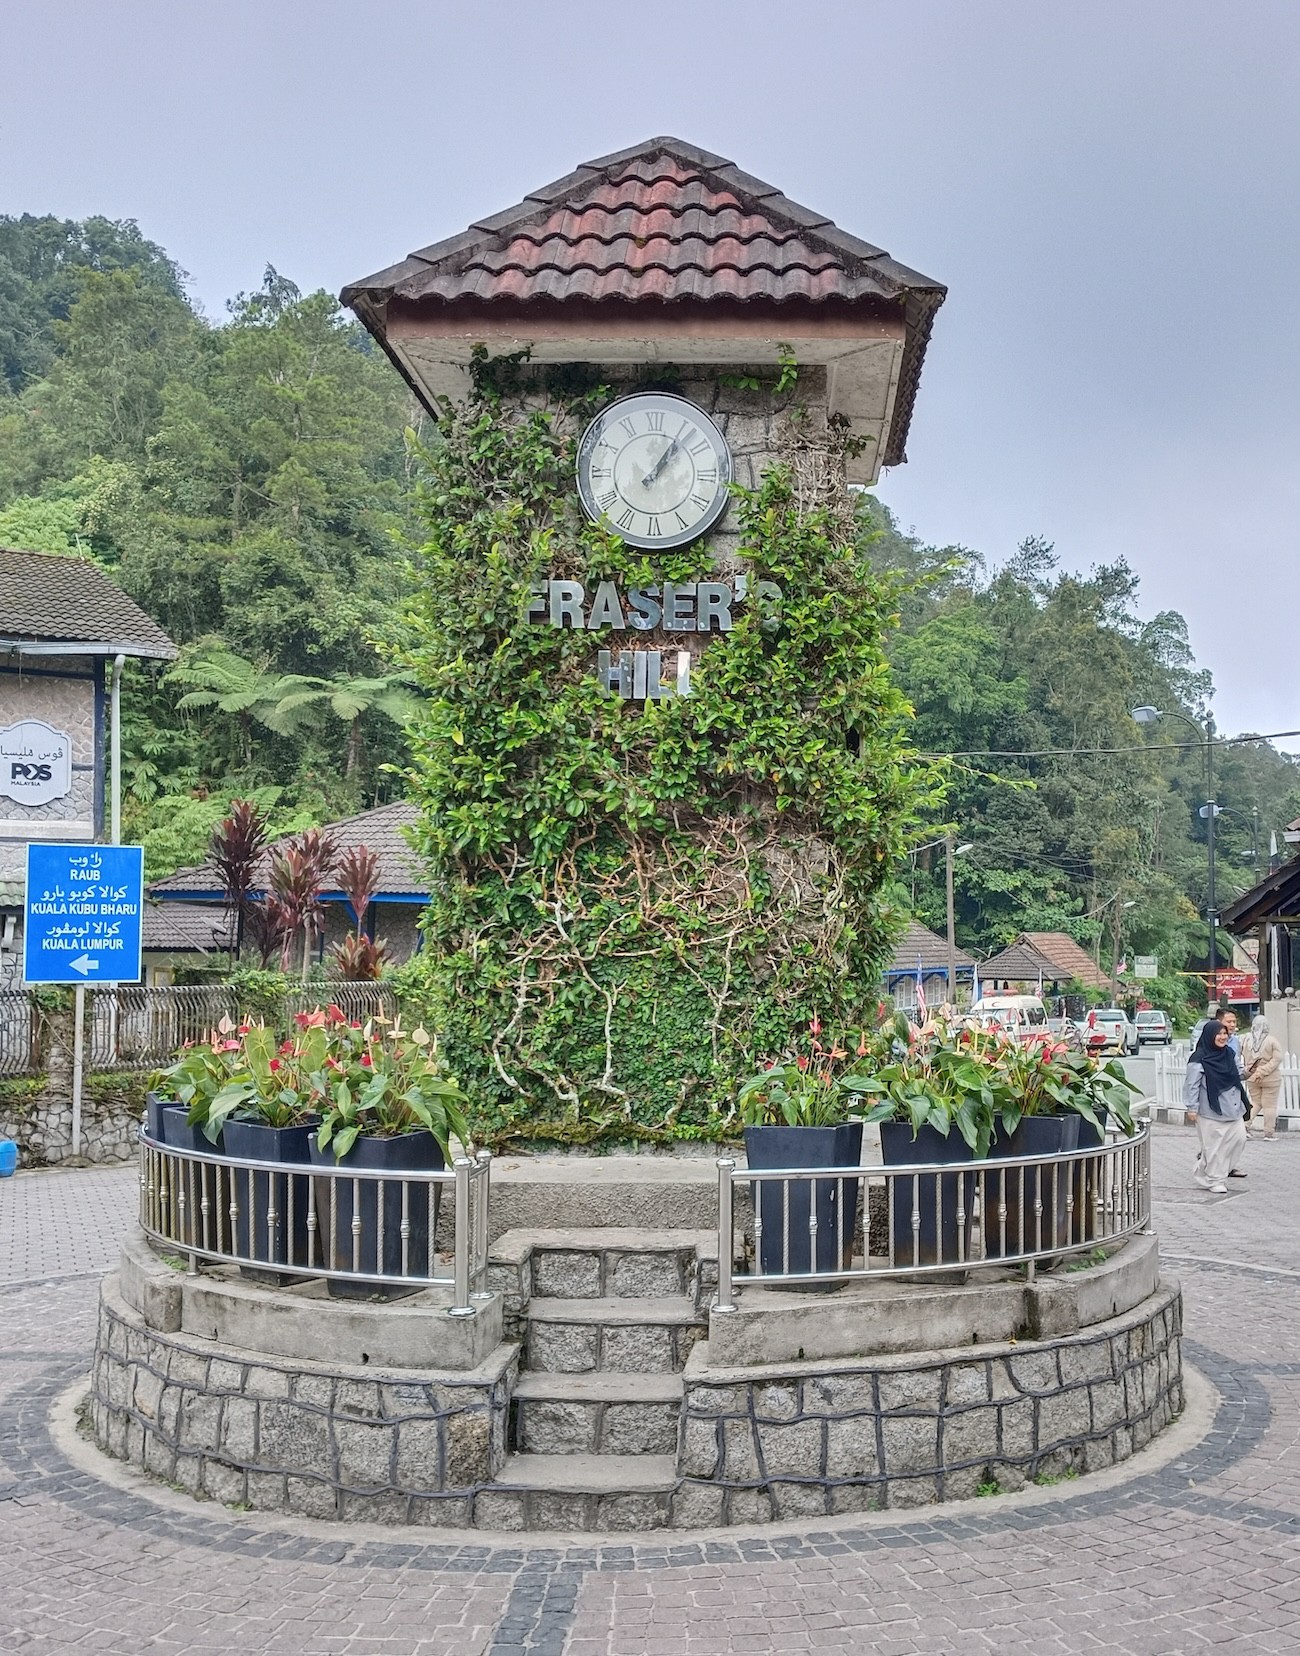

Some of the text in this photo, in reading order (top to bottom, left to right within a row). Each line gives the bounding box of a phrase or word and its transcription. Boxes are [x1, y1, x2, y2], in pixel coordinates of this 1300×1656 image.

[619, 416, 638, 439] XI
[645, 411, 665, 432] XII
[598, 437, 619, 455] X
[690, 438, 711, 456] II
[697, 467, 717, 484] III
[616, 508, 635, 530] VII
[646, 516, 662, 537] VI
[675, 511, 689, 531] V
[11, 762, 52, 781] POS
[70, 869, 100, 880] RAUB
[31, 902, 136, 915] KUALA KUBU BHARU
[42, 938, 124, 950] KUALA LUMPUR
